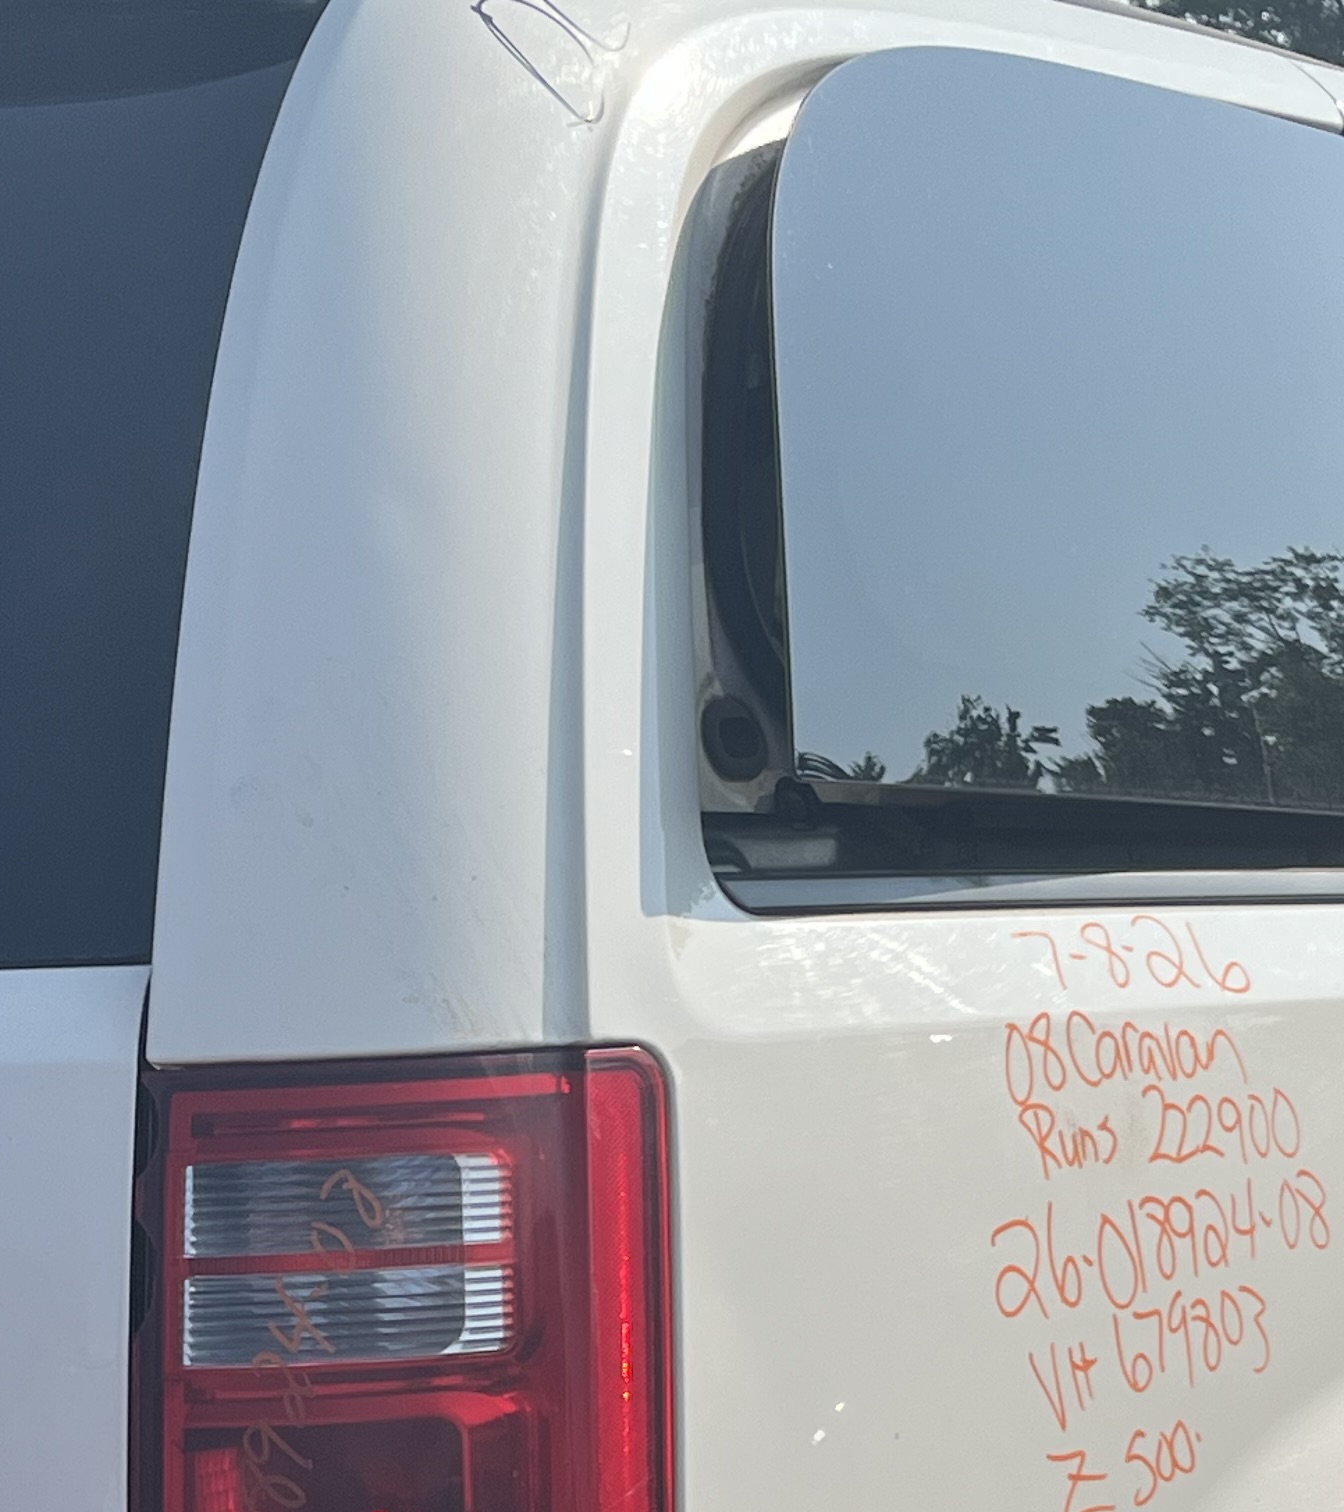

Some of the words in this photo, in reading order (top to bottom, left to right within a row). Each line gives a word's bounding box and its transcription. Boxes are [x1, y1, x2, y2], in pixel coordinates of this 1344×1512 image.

[1010, 914, 1252, 994] 7-8-26
[1017, 1102, 1119, 1181] Runs
[1141, 1083, 1301, 1166] 222900
[1111, 1284, 1272, 1394] 679803
